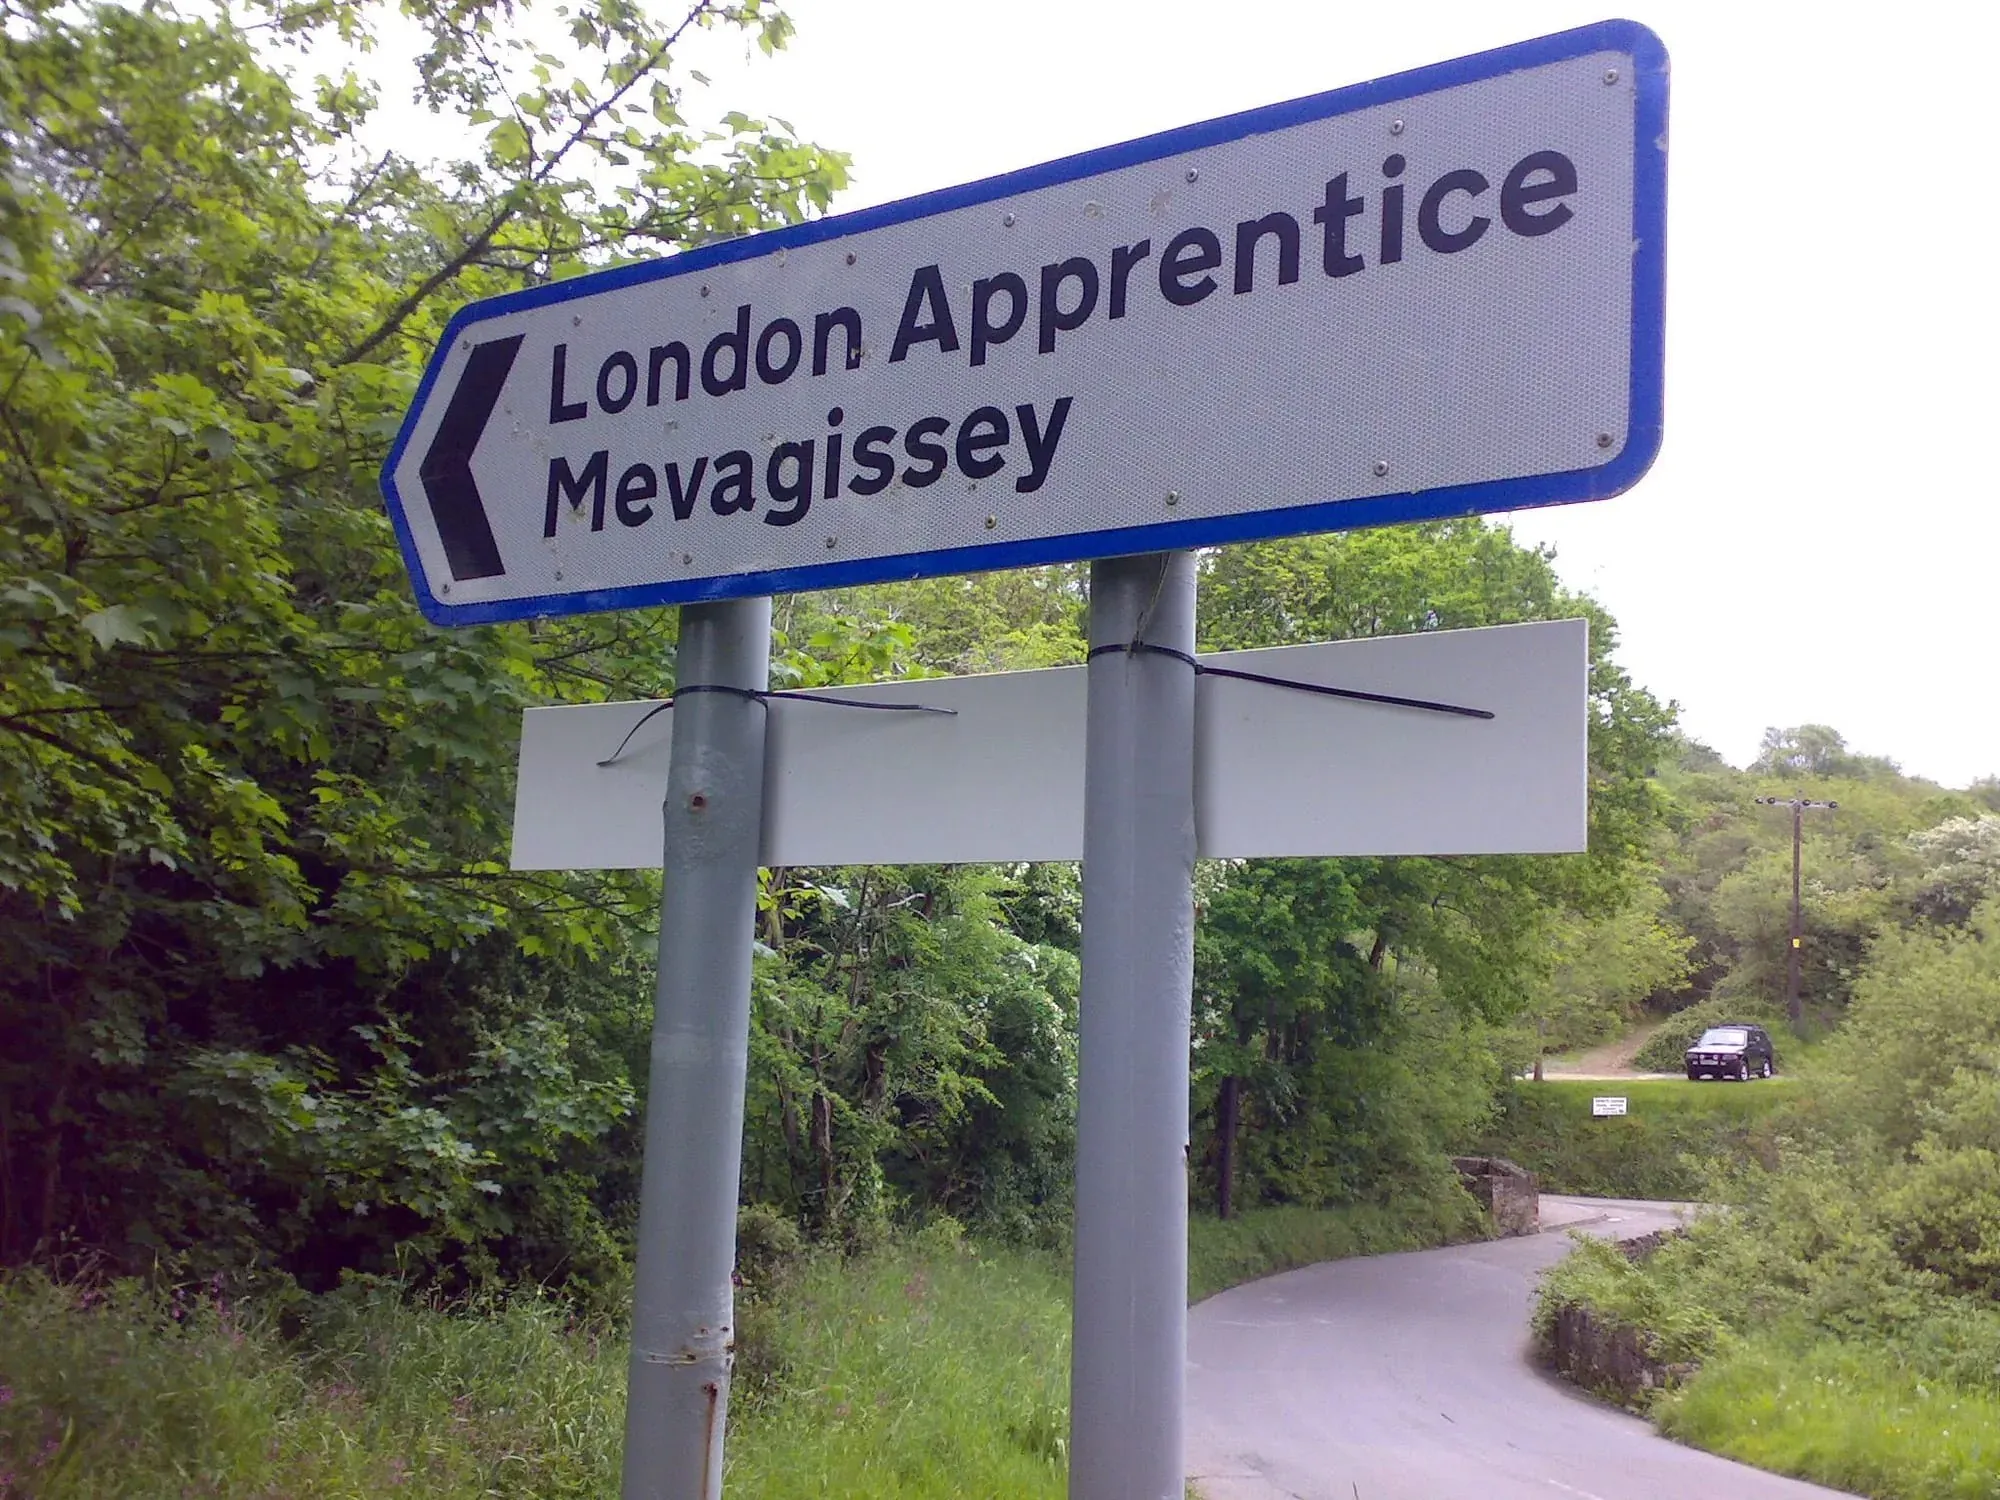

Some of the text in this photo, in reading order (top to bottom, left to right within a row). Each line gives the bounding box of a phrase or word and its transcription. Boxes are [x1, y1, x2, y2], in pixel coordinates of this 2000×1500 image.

[549, 149, 1578, 424] London Apprentice
[543, 397, 1074, 538] Mevagissey
